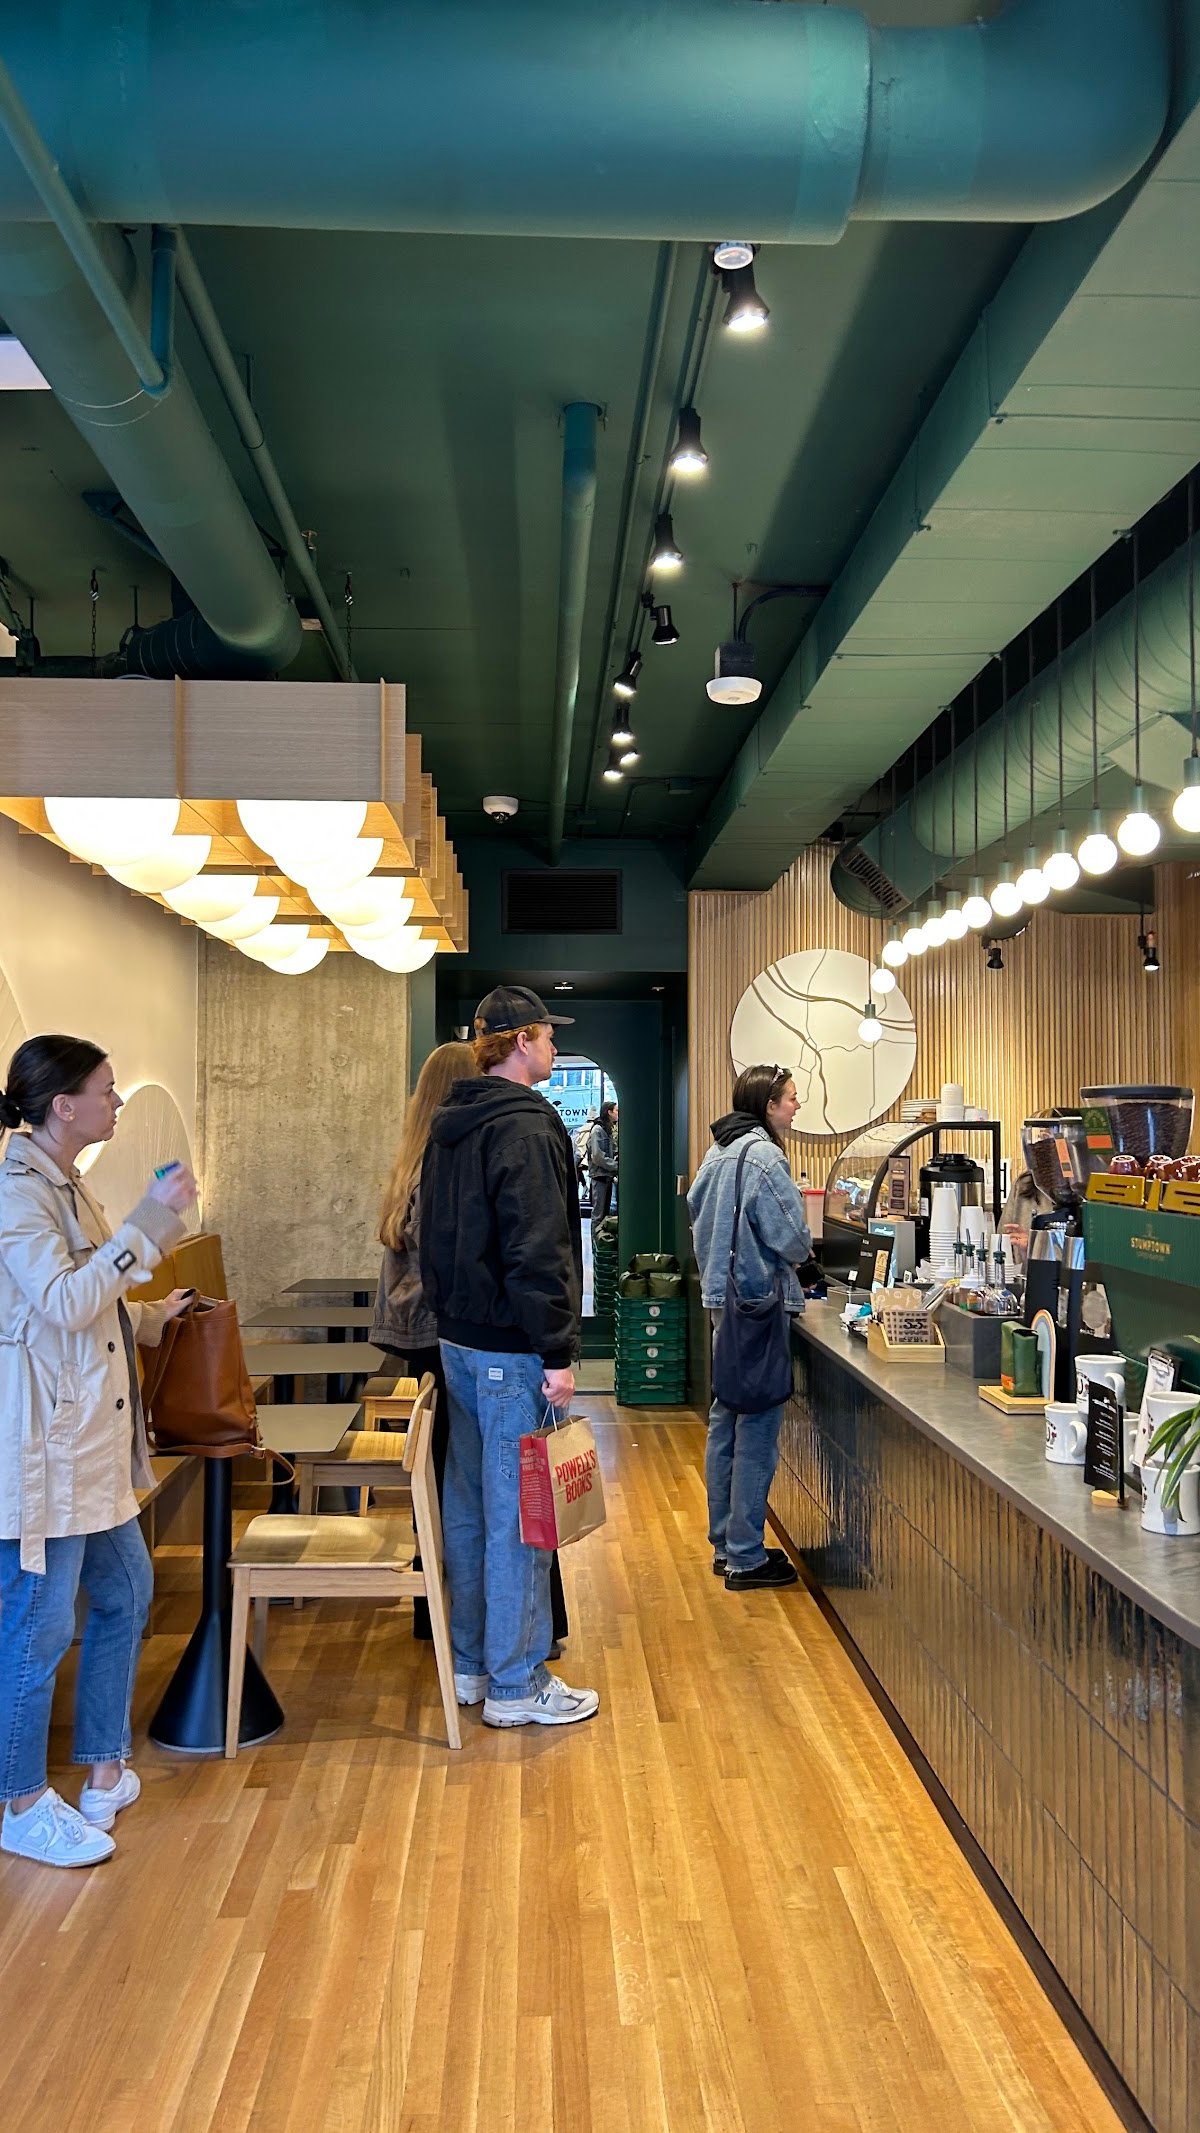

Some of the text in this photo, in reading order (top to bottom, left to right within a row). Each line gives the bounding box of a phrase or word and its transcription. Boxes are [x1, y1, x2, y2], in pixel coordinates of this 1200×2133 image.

[559, 1108, 588, 1117] TOWN
[1130, 1237, 1170, 1255] STUMPTOWN
[555, 1449, 597, 1486] POWELL'S
[565, 1473, 593, 1504] BOOKS
[534, 1691, 552, 1705] N
